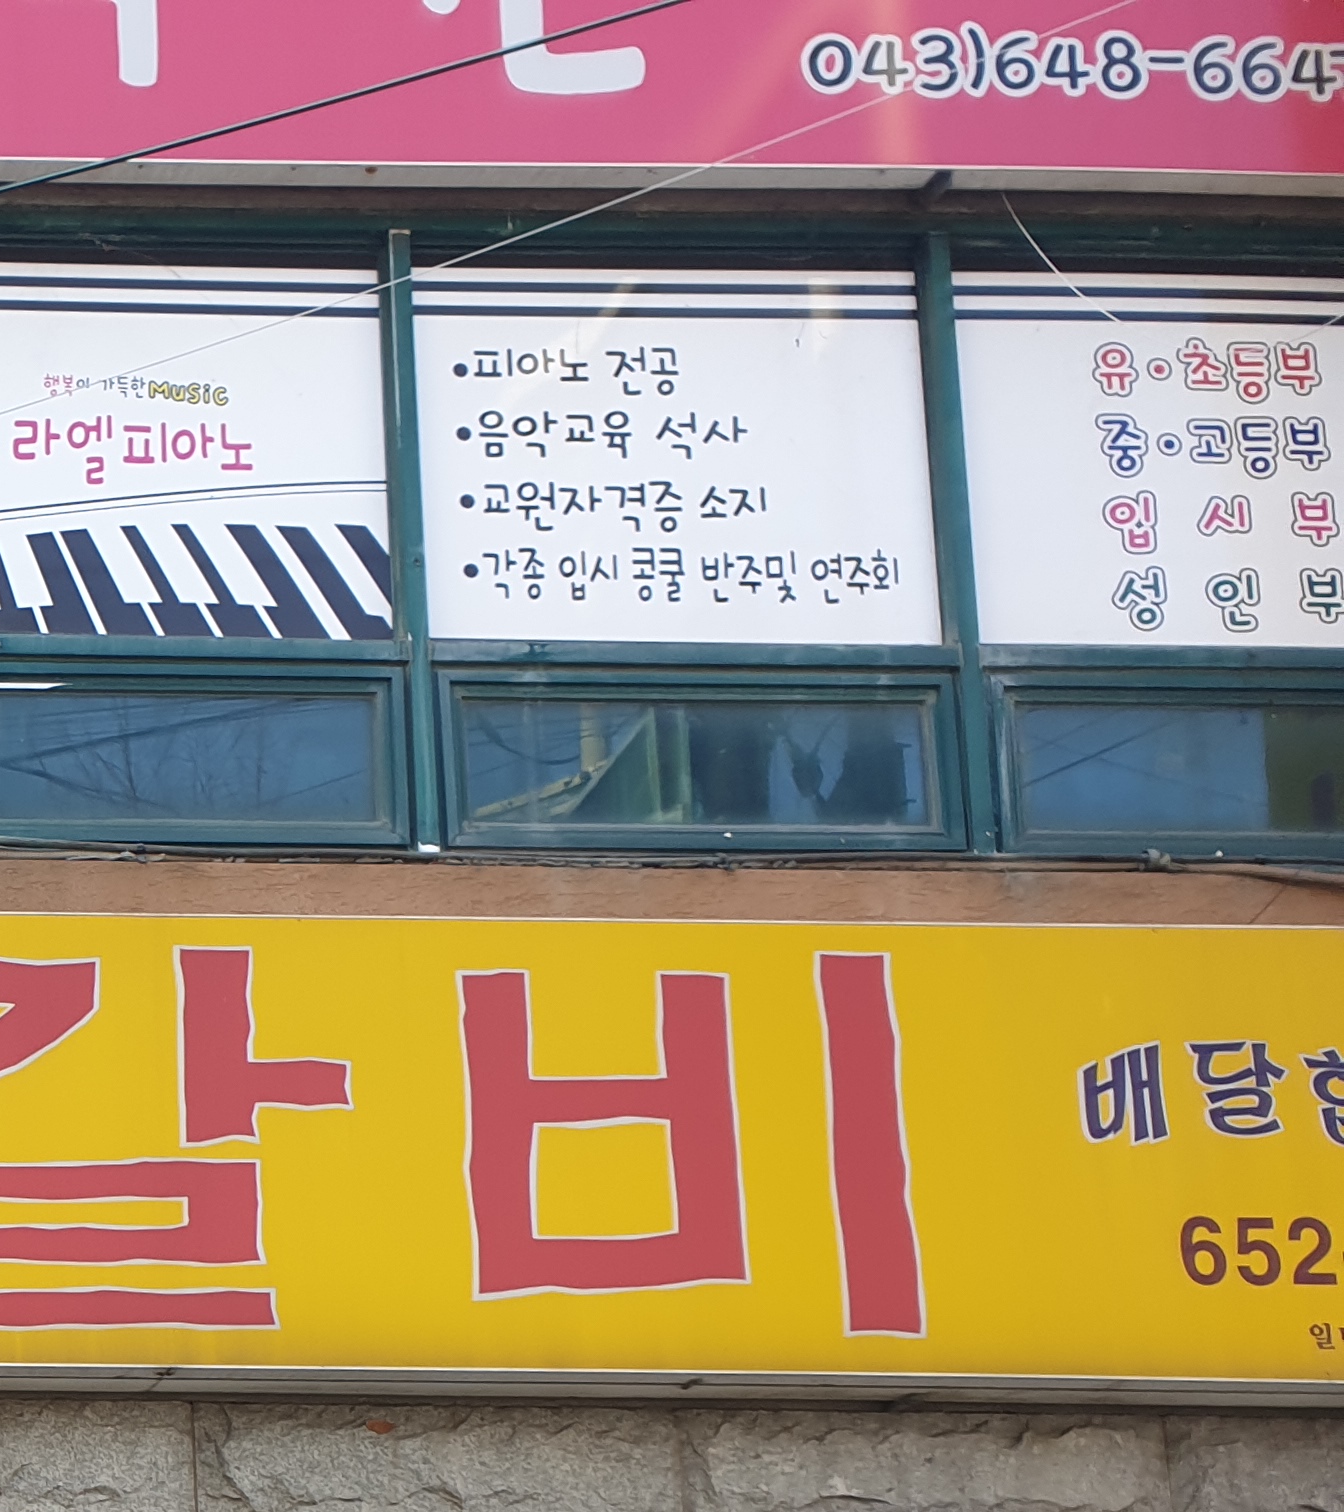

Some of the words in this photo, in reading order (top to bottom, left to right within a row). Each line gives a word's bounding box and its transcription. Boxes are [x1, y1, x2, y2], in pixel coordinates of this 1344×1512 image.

[801, 20, 1344, 102] 043)648-664
[473, 349, 589, 381] 피아노
[606, 346, 679, 396] 전공
[13, 414, 253, 484] 라엘피아노
[478, 410, 632, 458] 음악교육
[656, 412, 748, 459] 석사
[482, 481, 683, 532] 교원자격증
[700, 486, 767, 519] 소지
[482, 548, 545, 600] 각종
[558, 551, 618, 600] 입시
[631, 547, 685, 602] 콩쿨
[811, 549, 899, 603] 연주회
[1180, 1216, 1344, 1287] 652
